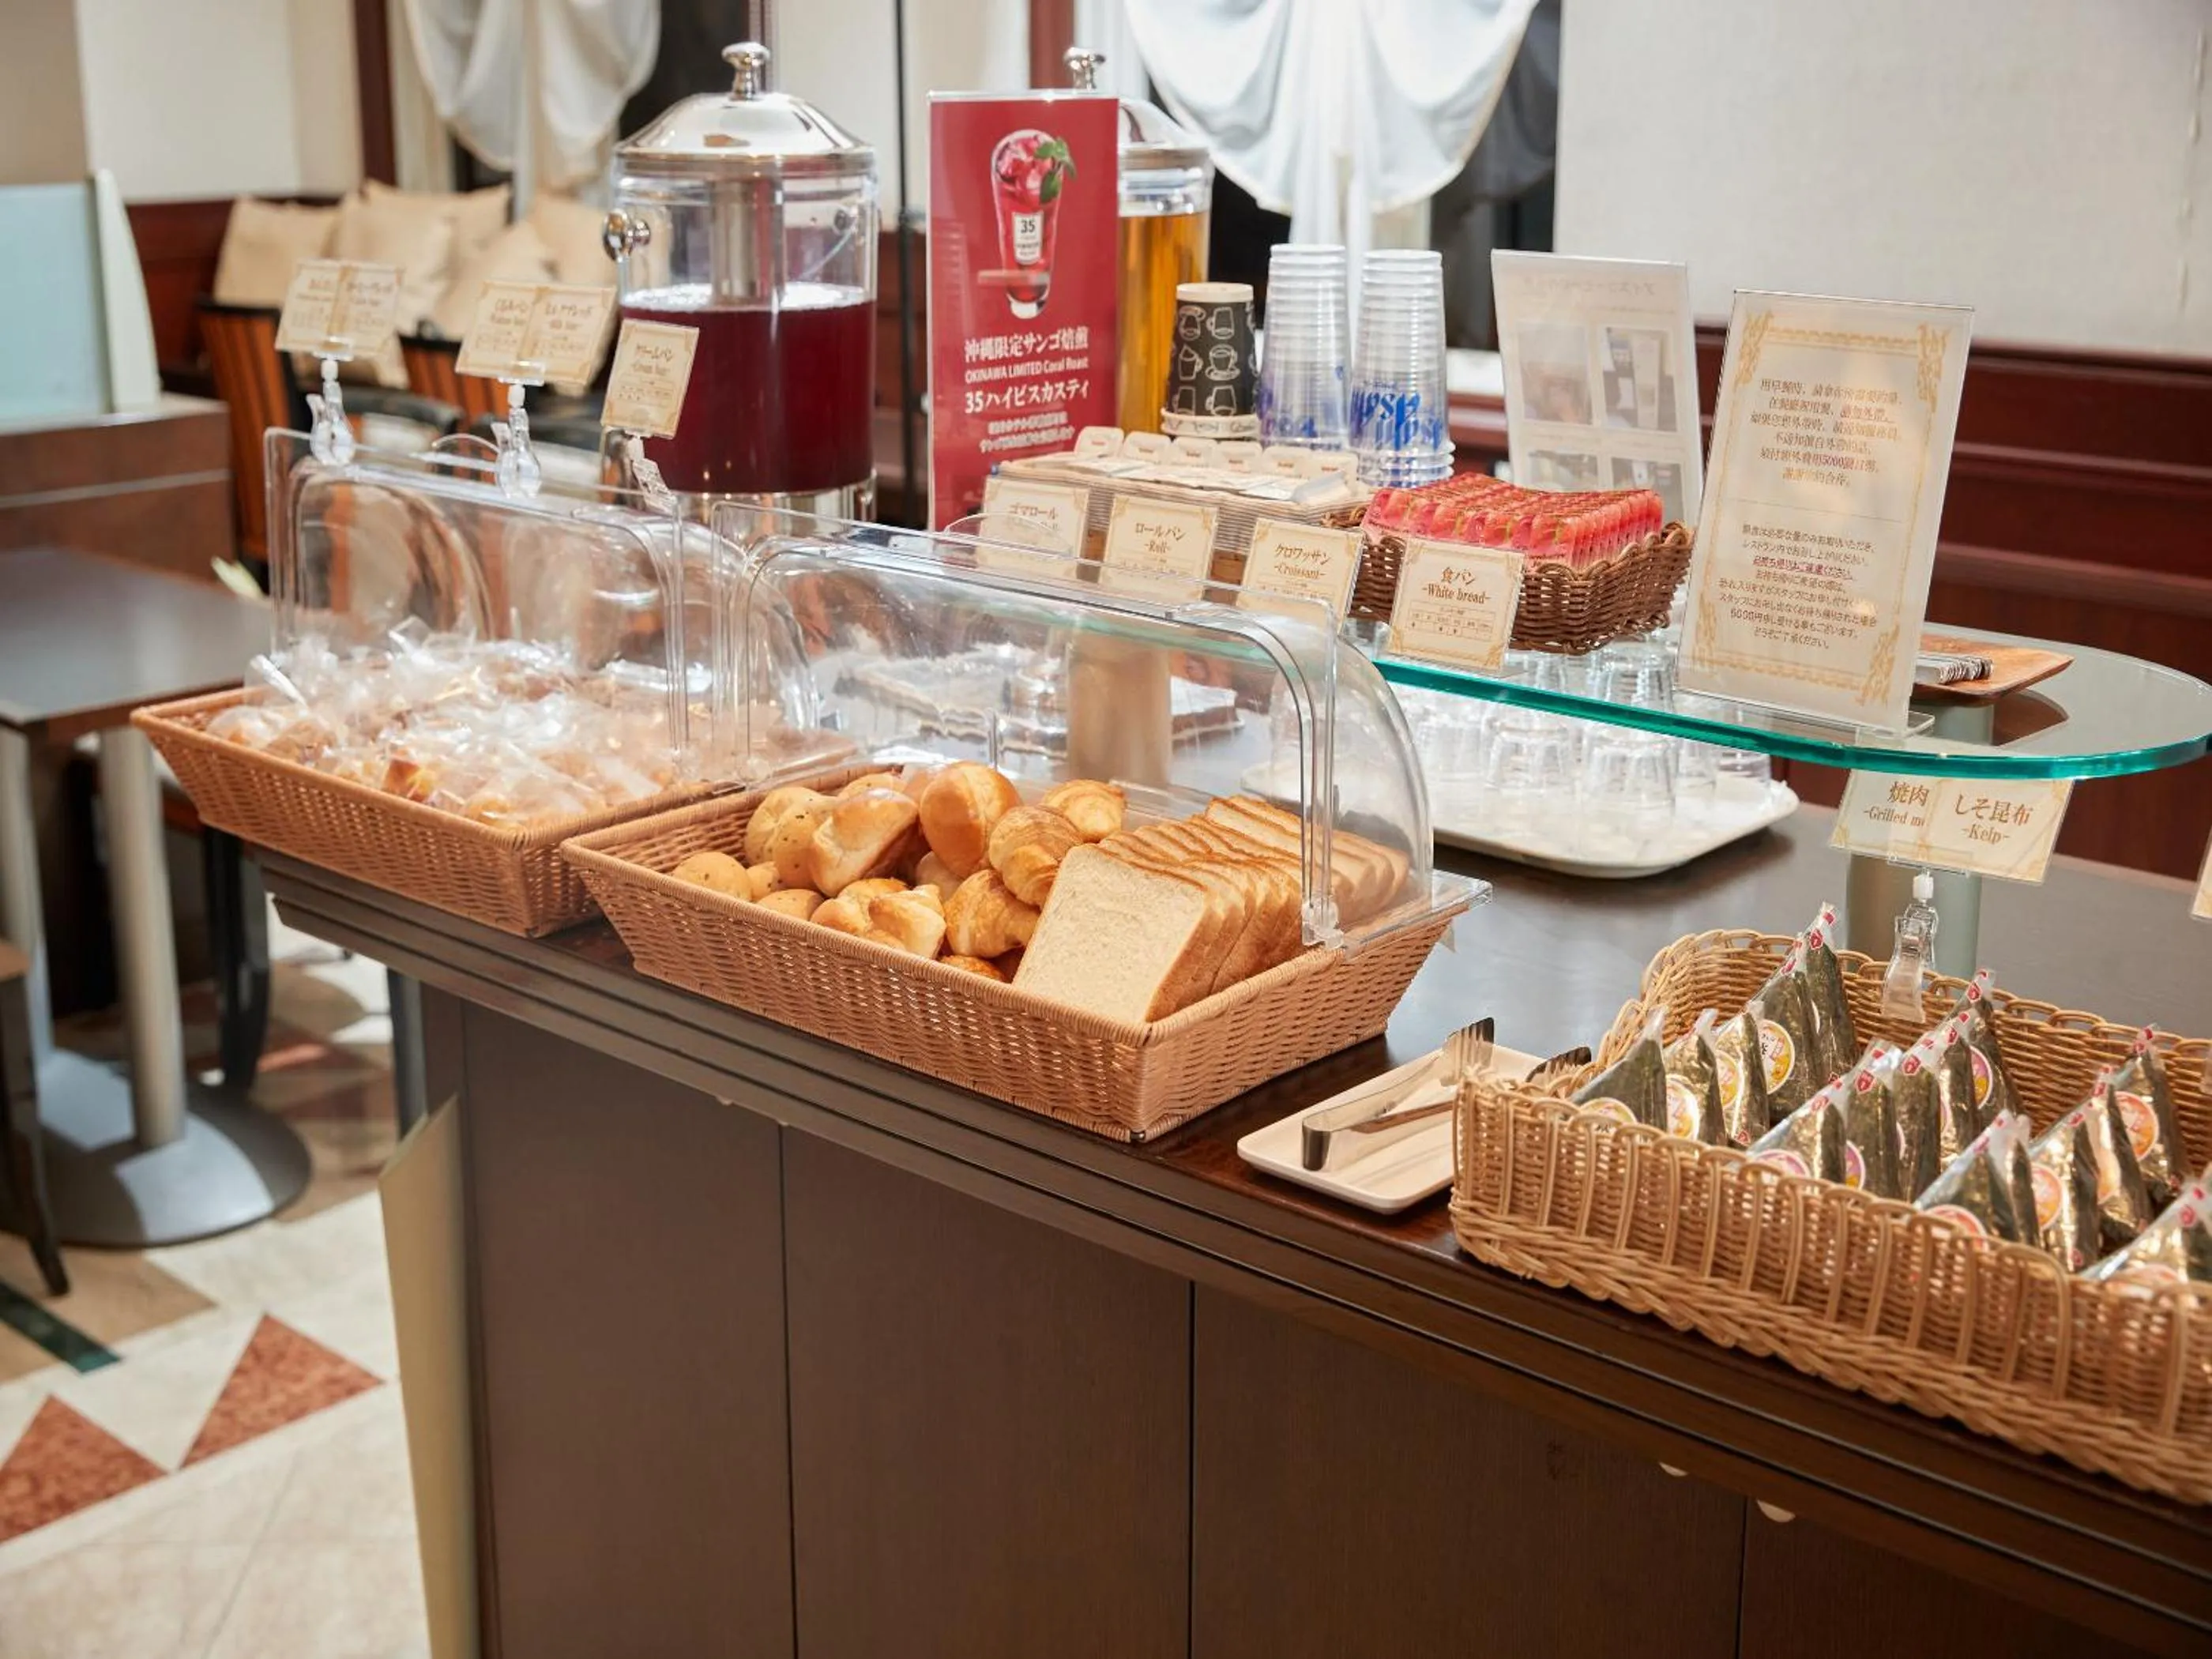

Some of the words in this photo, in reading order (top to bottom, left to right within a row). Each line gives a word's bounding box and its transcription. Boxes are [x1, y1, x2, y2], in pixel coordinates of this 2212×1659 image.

[1021, 218, 1036, 234] 35
[965, 366, 1007, 383] OKINAWA
[1008, 359, 1043, 378] LIMITED
[1135, 522, 1187, 542] ロールパン
[1274, 543, 1332, 566] クロワッサン
[1441, 566, 1476, 586] 食パン
[1887, 781, 1929, 807] 焼肉
[1955, 793, 2033, 826] しそ昆布
